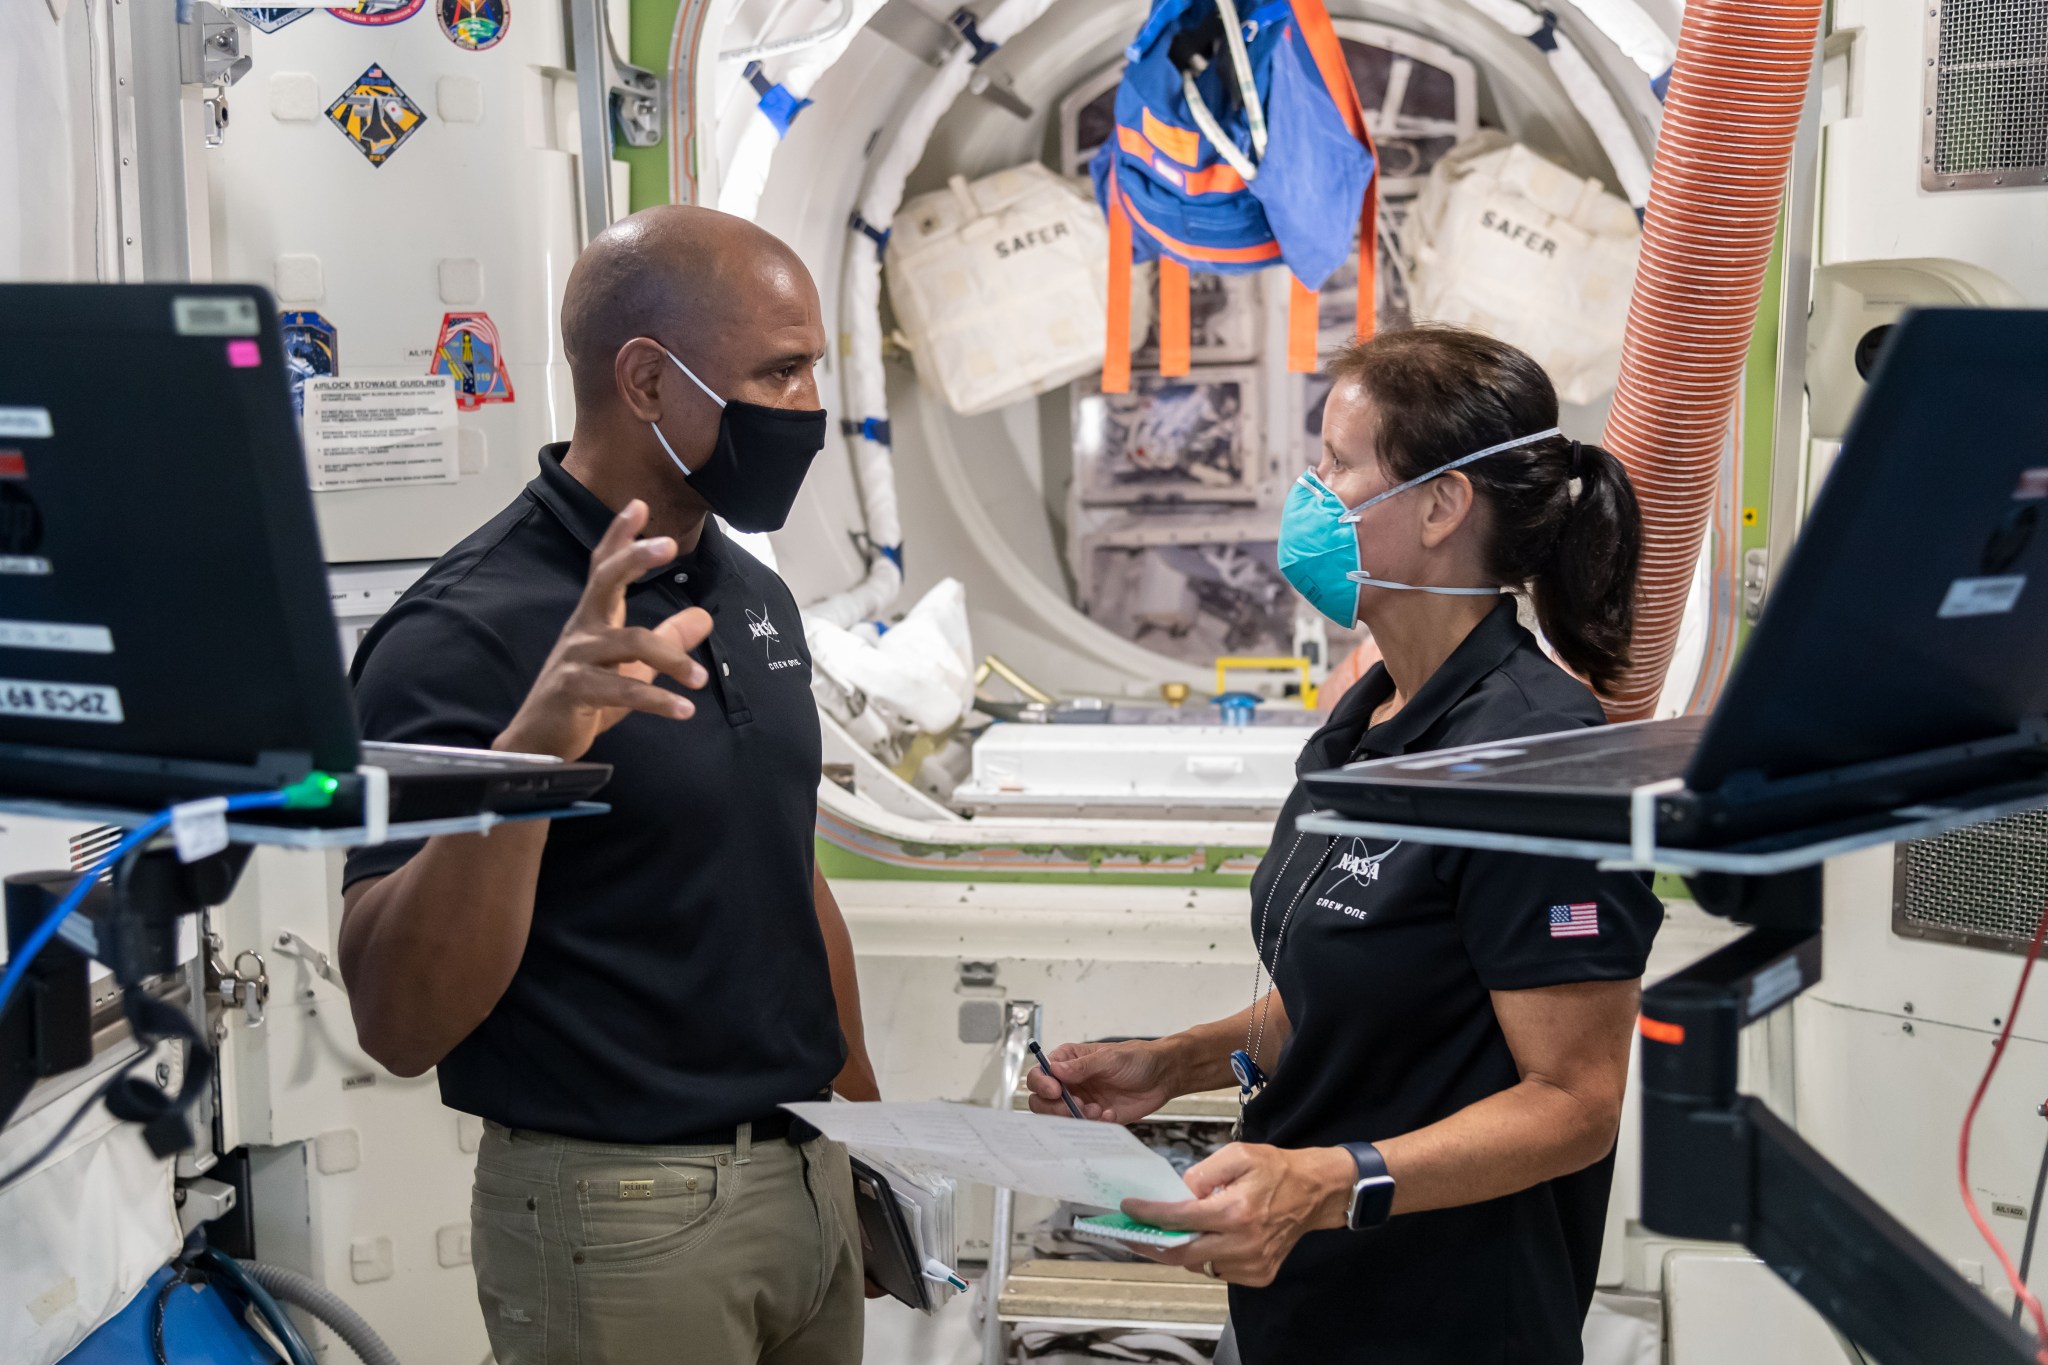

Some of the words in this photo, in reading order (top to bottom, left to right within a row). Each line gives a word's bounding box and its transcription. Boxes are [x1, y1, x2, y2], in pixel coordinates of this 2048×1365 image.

[994, 221, 1070, 259] SAFER
[1481, 209, 1558, 259] SAFER
[313, 380, 351, 390] AIRLOCK
[353, 379, 398, 389] STOWAGE
[400, 378, 446, 388] GUIDLINES
[768, 660, 788, 671] CREW
[1337, 852, 1380, 881] NASA
[1315, 897, 1344, 912] CREW
[1343, 905, 1368, 920] ONE
